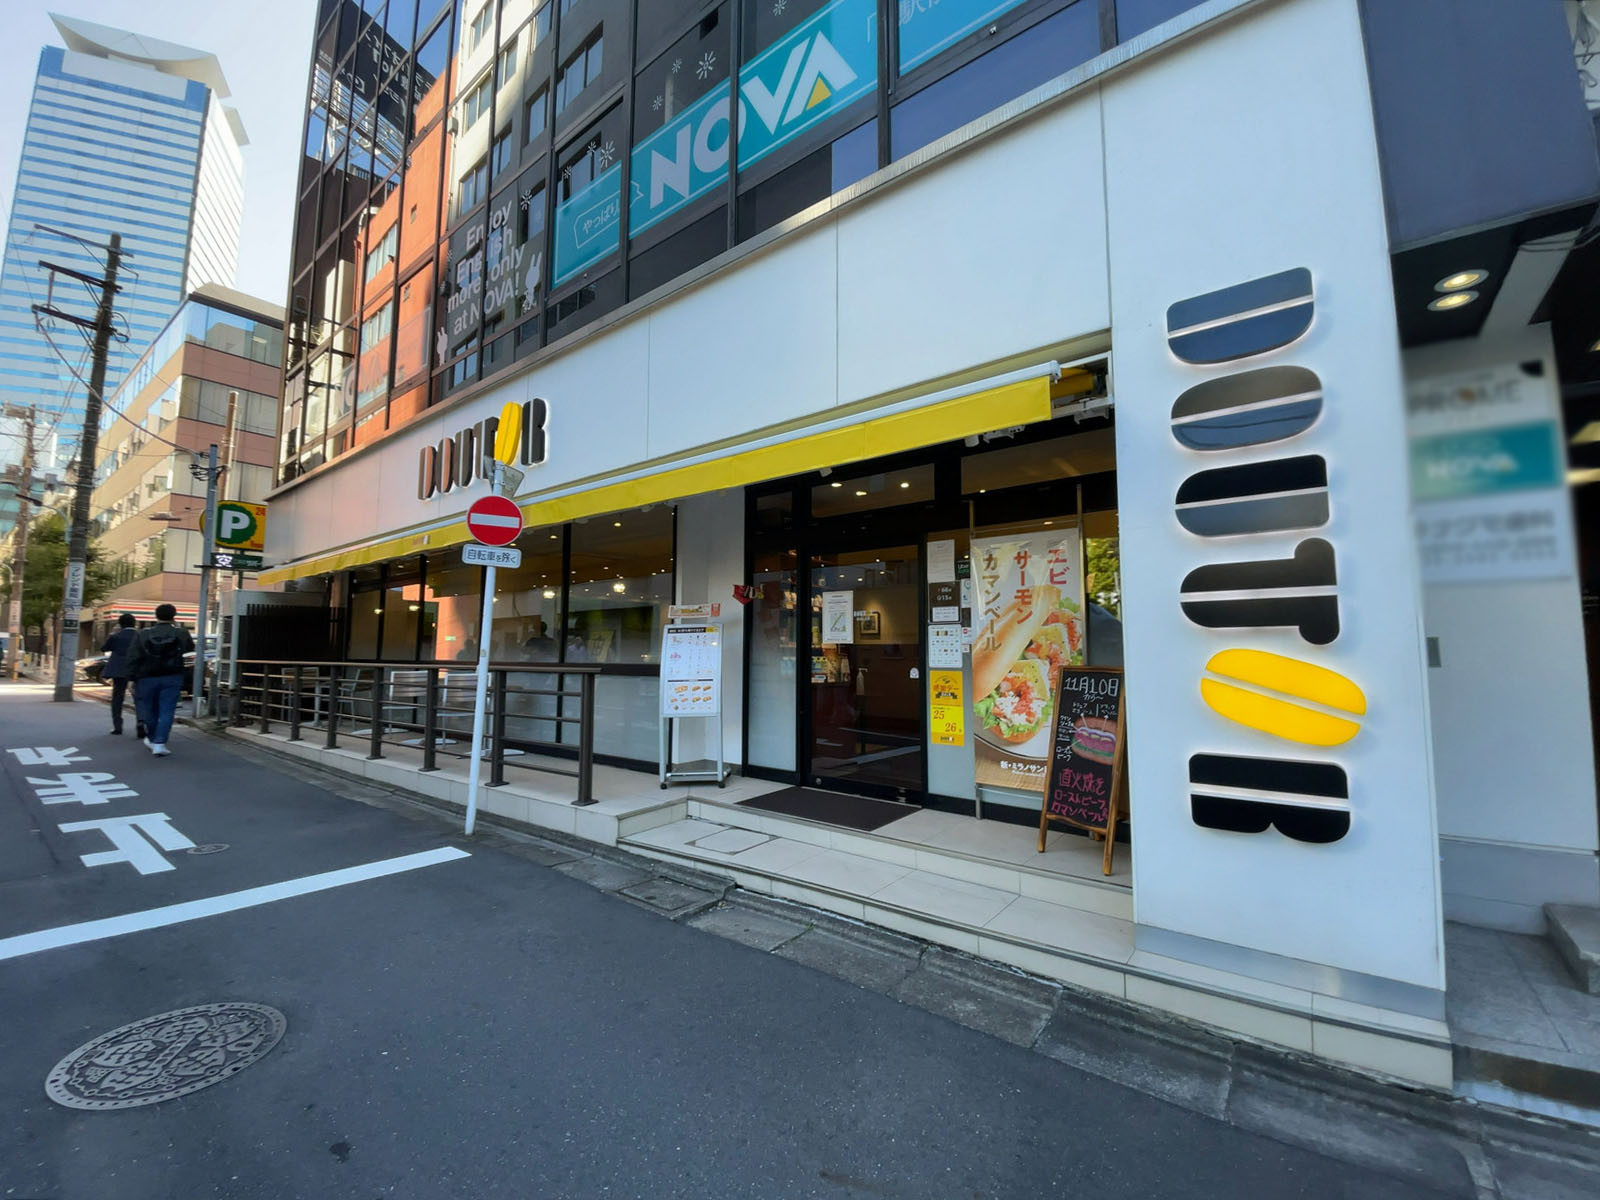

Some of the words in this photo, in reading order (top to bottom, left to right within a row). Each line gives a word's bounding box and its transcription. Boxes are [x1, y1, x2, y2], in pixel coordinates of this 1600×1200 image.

[649, 31, 858, 209] NOVA
[466, 201, 512, 251] Enjoy
[491, 243, 525, 282] only
[453, 308, 468, 335] at
[470, 271, 520, 325] NOVA!
[418, 398, 547, 500] DOUTOR
[220, 509, 250, 539] P
[467, 548, 516, 564] 自転車を除く
[1047, 548, 1070, 585] エビ
[1167, 266, 1367, 845] DOUTOR
[983, 553, 1001, 651] カマンベール
[1013, 550, 1032, 625] サーモン
[1063, 676, 1119, 697] 11月10日
[934, 710, 945, 720] 25
[945, 722, 957, 733] 26
